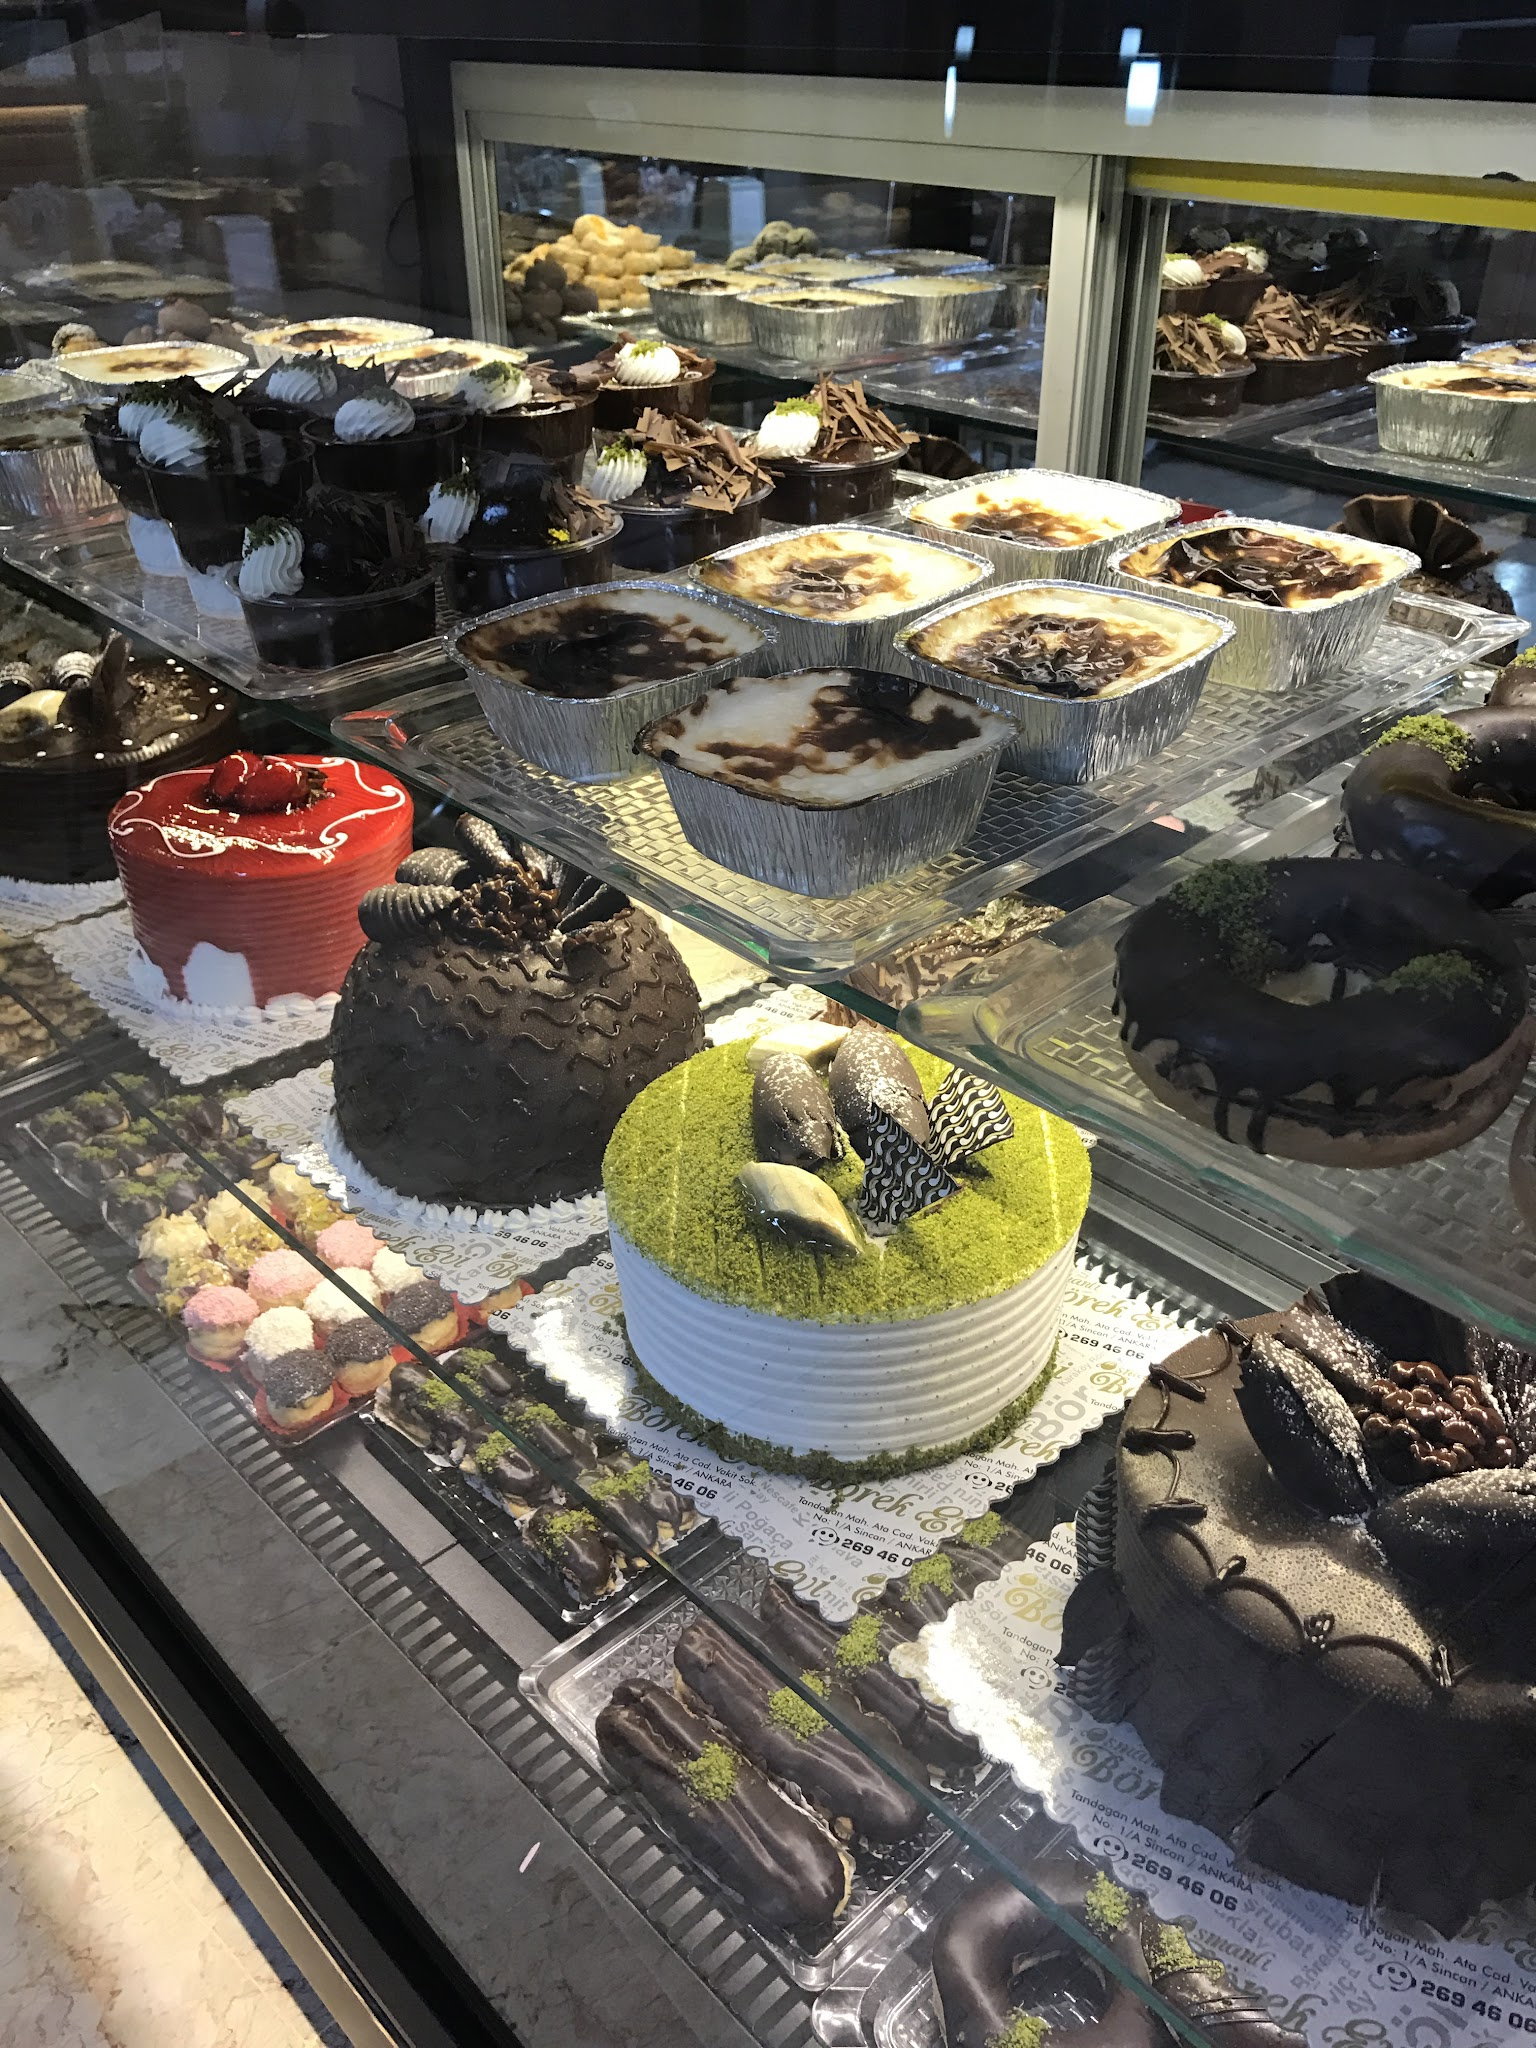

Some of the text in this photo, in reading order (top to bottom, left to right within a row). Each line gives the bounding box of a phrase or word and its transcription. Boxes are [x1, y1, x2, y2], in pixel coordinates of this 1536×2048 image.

[513, 1236, 530, 1244] 46
[531, 1239, 549, 1248] 06
[414, 1244, 478, 1269] Evi
[591, 1256, 615, 1270] 269
[1070, 1333, 1144, 1360] 269 46 06
[650, 1442, 672, 1457] Mah.
[673, 1450, 690, 1463] Ata
[691, 1457, 712, 1471] Cad.
[715, 1465, 738, 1482] Vakit
[738, 1474, 758, 1487] Sok.
[964, 1460, 982, 1470] No:
[986, 1466, 1002, 1476] 1/A
[996, 1460, 1020, 1471] Mah.
[673, 1477, 695, 1491] 46
[696, 1485, 718, 1500] 06
[693, 1469, 733, 1489] ANKARA
[735, 1499, 794, 1552] Poğaça
[812, 1513, 831, 1525] No:
[835, 1520, 851, 1533] 1/A
[853, 1527, 886, 1544] Sincan
[845, 1513, 870, 1528] Mah.
[871, 1522, 890, 1534] Ata
[892, 1527, 915, 1542] Cad.
[841, 1537, 875, 1556] 269
[876, 1550, 900, 1564] 46
[1026, 1548, 1073, 1575] 46 06
[1002, 1626, 1054, 1656] Tandogan
[1020, 1648, 1041, 1664] No:
[1071, 1789, 1129, 1824] Tandogan
[1131, 1816, 1161, 1838] Mah.
[1166, 1833, 1187, 1849] Ata
[1192, 1843, 1219, 1863] Cad.
[1092, 1814, 1113, 1830] No:
[1120, 1827, 1141, 1844] 1/A
[1145, 1837, 1185, 1864] Sincan
[1198, 1864, 1254, 1895] ANKARA
[1131, 1852, 1239, 1911] 269 46 06
[1371, 1938, 1397, 1955] No:
[1404, 1950, 1428, 1970] 1/A
[1431, 1961, 1478, 1988] Sincan
[1414, 1939, 1449, 1962] Mah.
[1453, 1955, 1478, 1973] Ata
[1482, 1965, 1514, 1986] Cad.
[1420, 1979, 1536, 2034] 269 46 06
